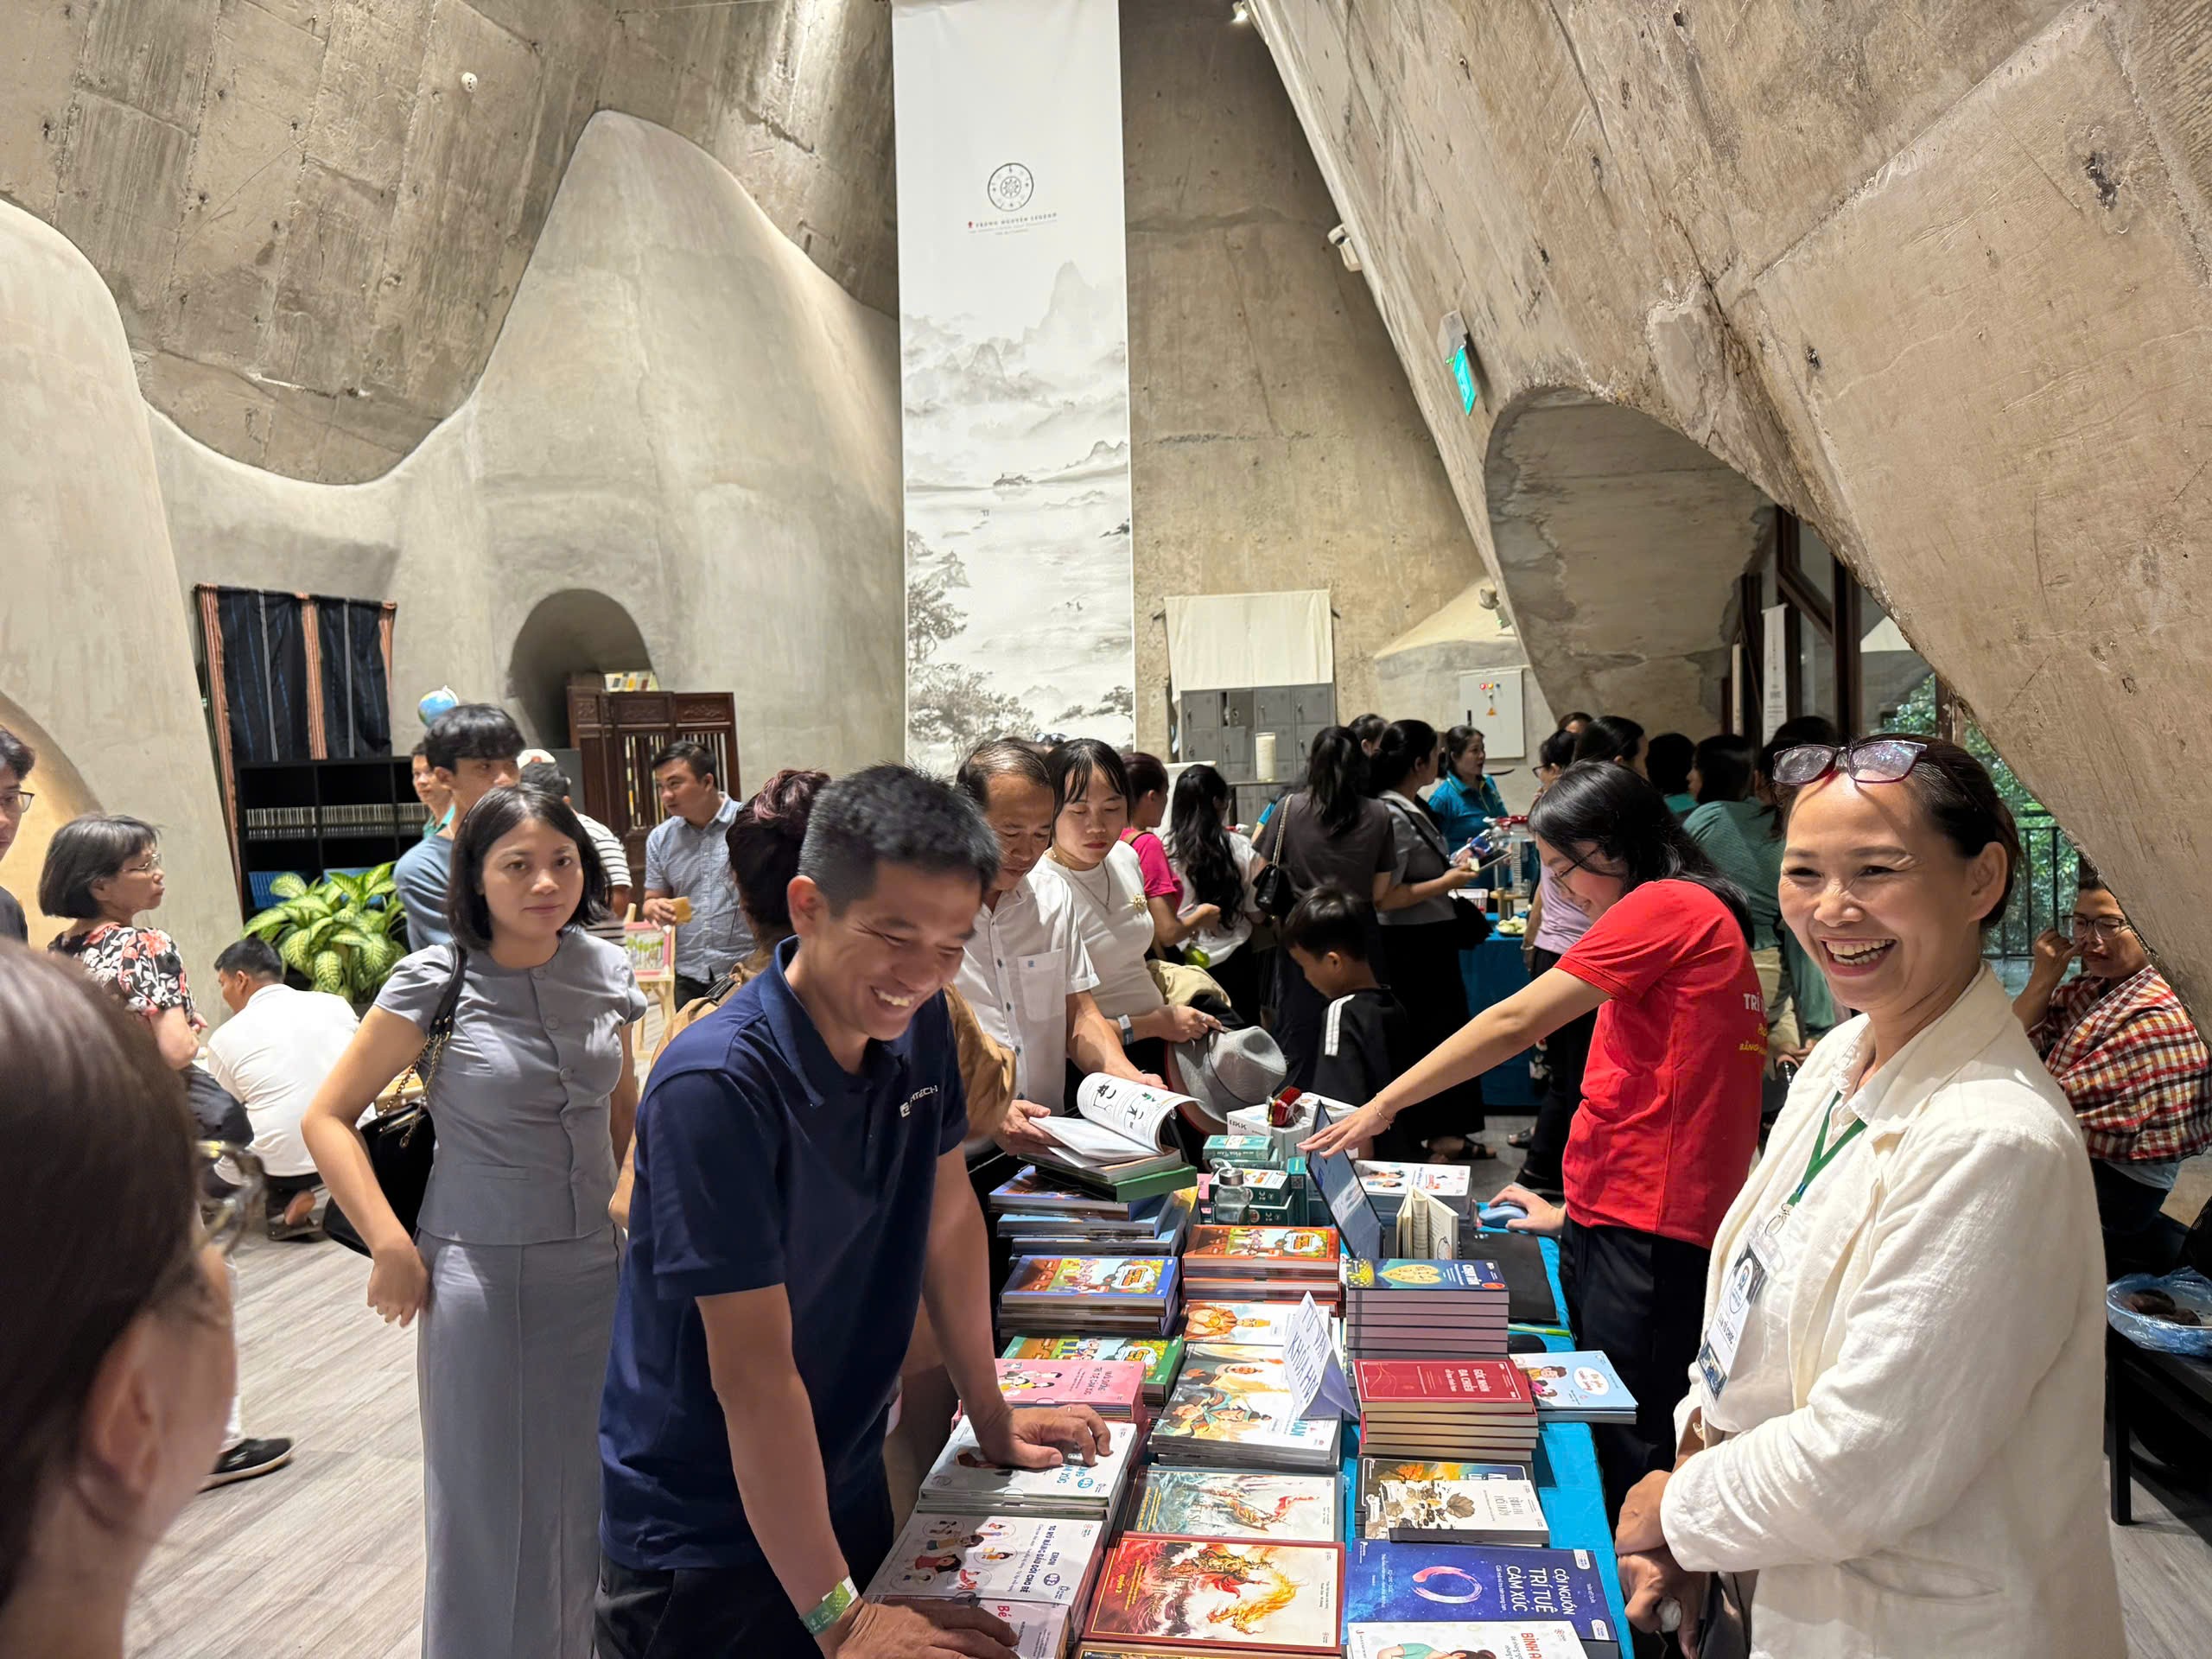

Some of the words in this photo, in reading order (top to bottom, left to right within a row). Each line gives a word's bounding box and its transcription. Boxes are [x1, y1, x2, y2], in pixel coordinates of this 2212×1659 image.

[1506, 1566, 1527, 1589] CẢM
[1529, 1567, 1553, 1588] TRÍ
[1552, 1568, 1570, 1583] CỘI
[1510, 1591, 1530, 1611] XÚC
[1531, 1590, 1558, 1613] TUỆ
[997, 1605, 1012, 1618] Bé
[1521, 1632, 1539, 1651] BÌNH
